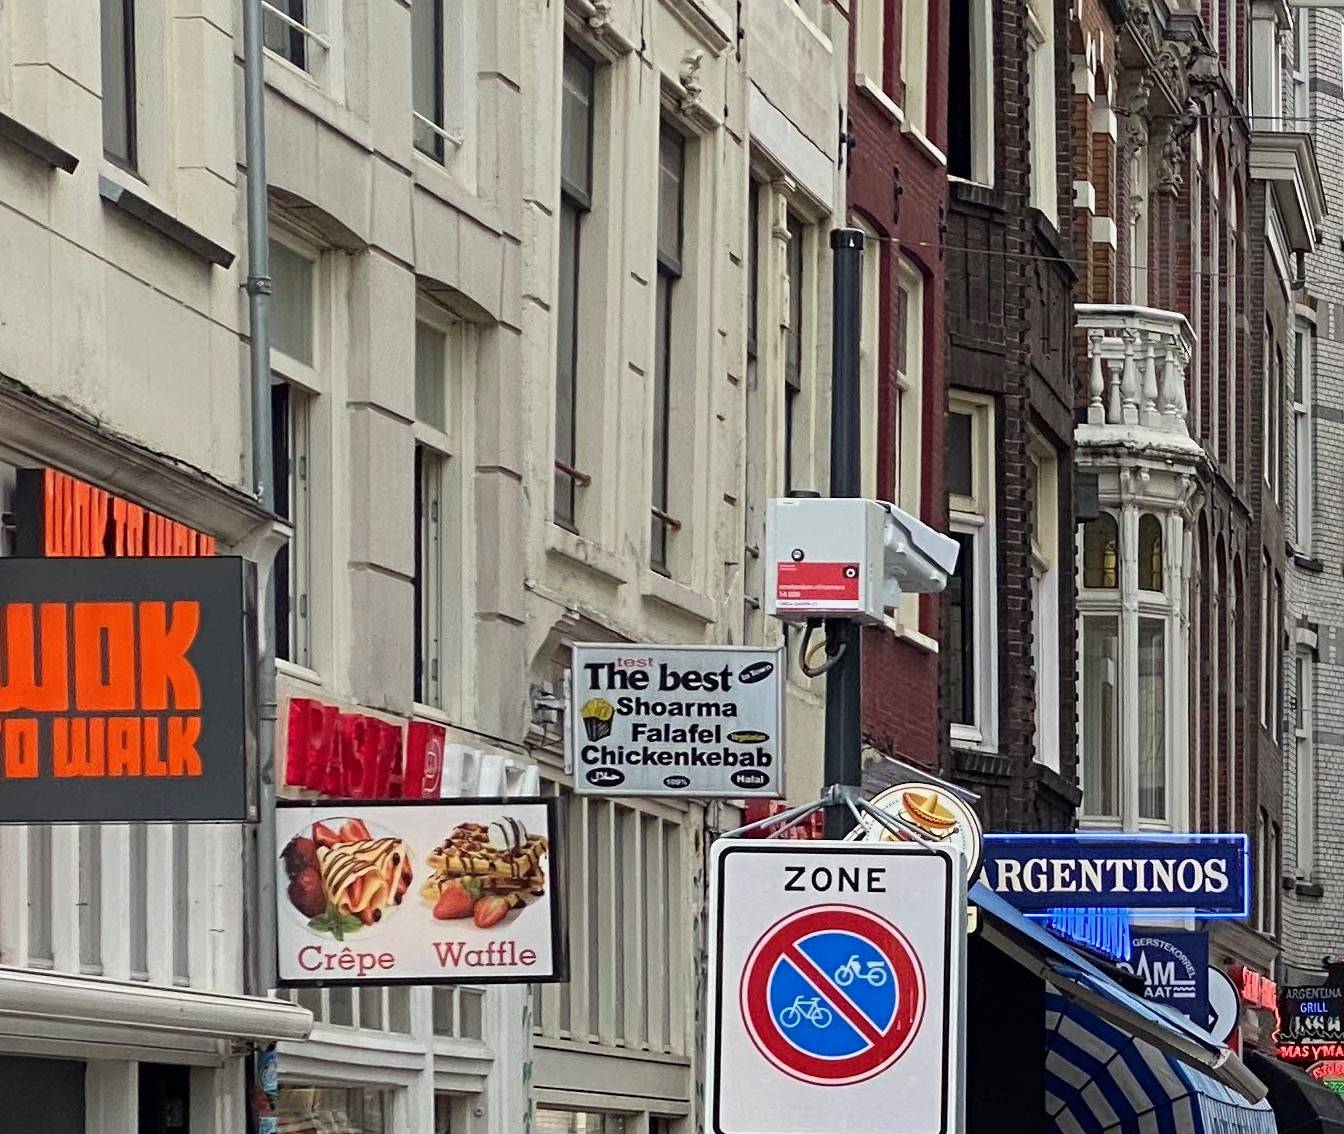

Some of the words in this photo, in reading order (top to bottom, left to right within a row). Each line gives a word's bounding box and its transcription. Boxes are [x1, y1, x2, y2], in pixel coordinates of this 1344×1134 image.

[0, 601, 201, 711] WOK
[584, 663, 649, 690] The
[658, 663, 732, 692] best
[616, 697, 738, 717] Shoarma
[632, 723, 722, 744] Falafel
[0, 718, 38, 777] O
[53, 716, 202, 777] WALK
[581, 745, 772, 767] Chickenkebab
[737, 775, 764, 784] Halal
[784, 866, 886, 893] ZONE
[298, 946, 395, 976] Crêpe
[433, 941, 537, 967] Waffle
[1144, 988, 1172, 998] AAT
[1300, 1002, 1328, 1013] GRILL
